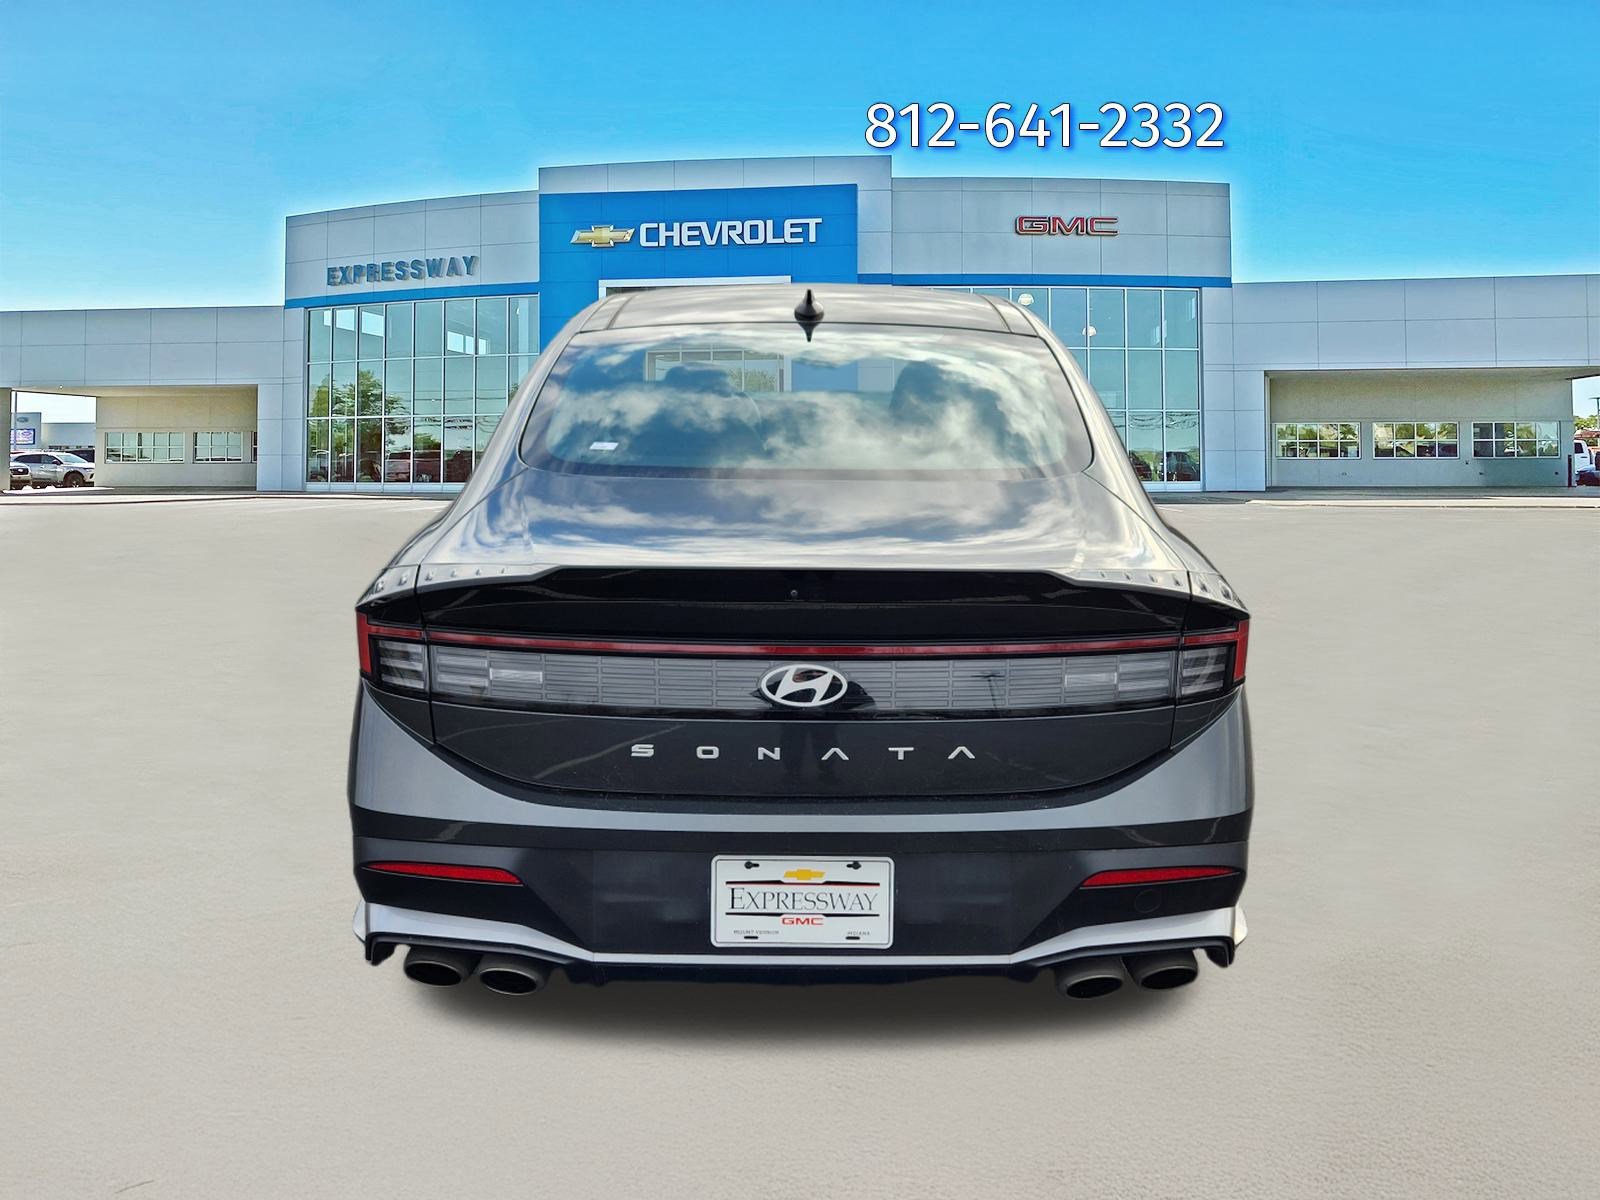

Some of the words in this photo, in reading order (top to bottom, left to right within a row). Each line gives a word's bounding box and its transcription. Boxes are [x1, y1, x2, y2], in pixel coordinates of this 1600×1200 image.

[638, 217, 823, 248] CHEVROLET
[1014, 215, 1119, 236] GMC
[326, 255, 480, 286] EXPRESSWAY
[631, 743, 976, 761] SONATA
[728, 887, 878, 911] EXPRESSWAY
[781, 917, 824, 926] GMC
